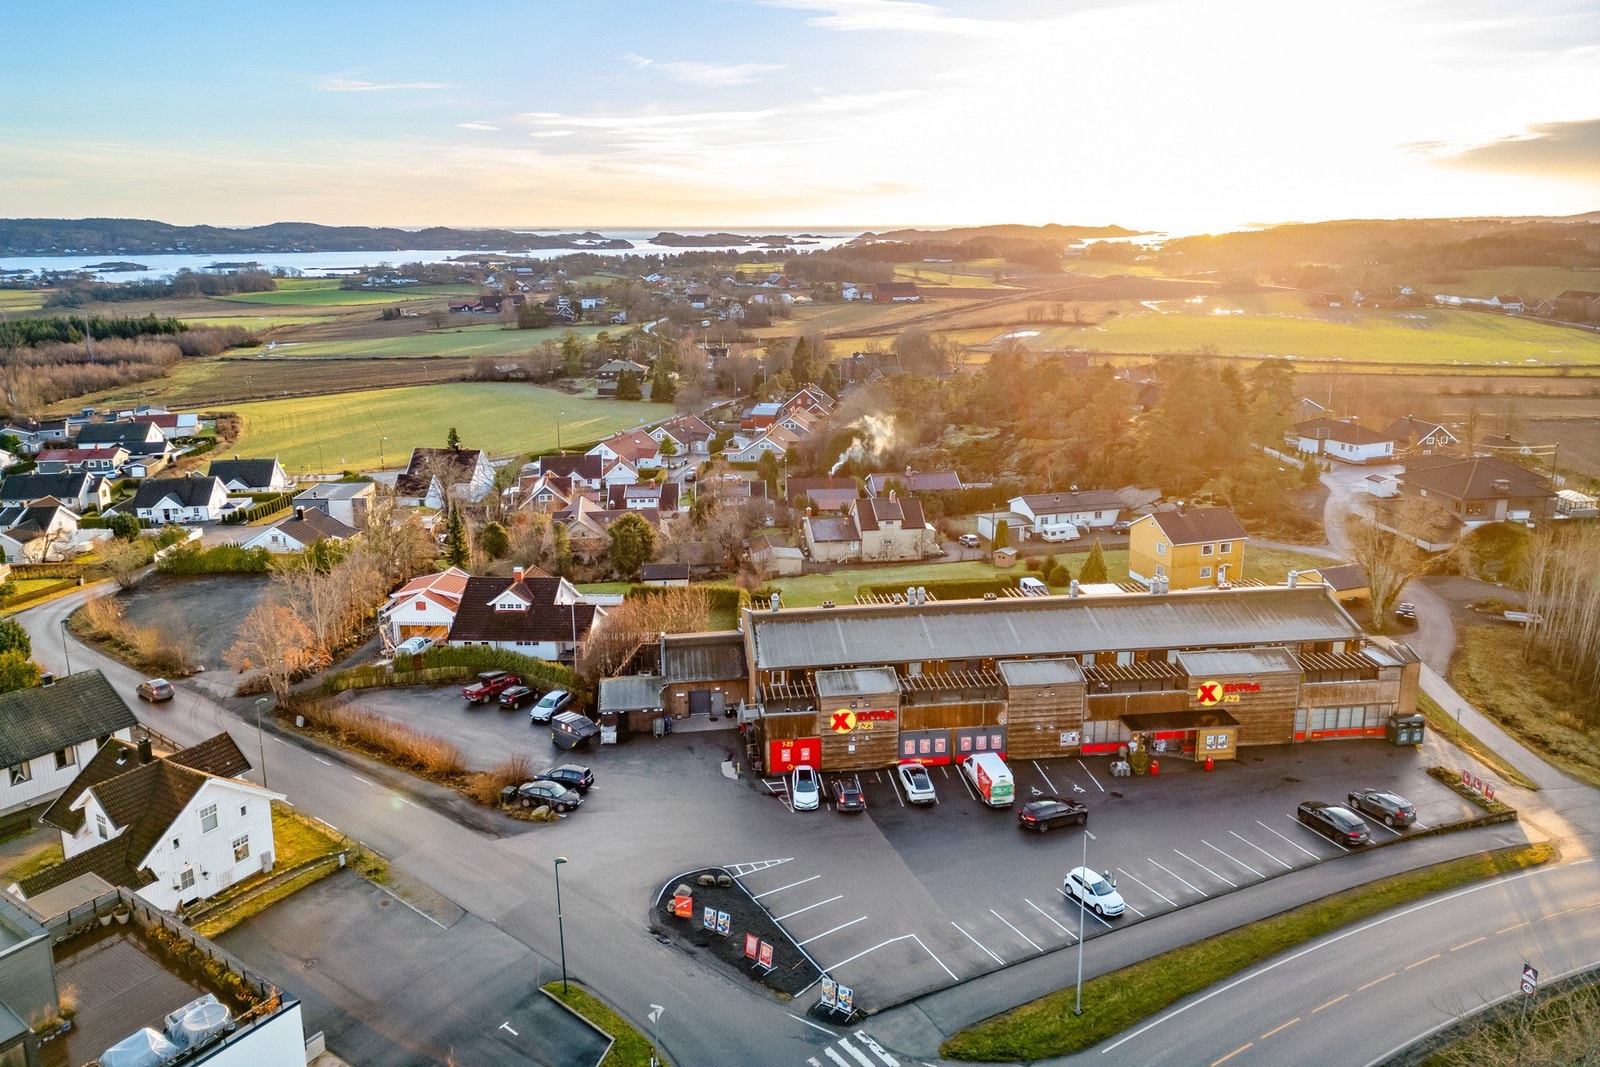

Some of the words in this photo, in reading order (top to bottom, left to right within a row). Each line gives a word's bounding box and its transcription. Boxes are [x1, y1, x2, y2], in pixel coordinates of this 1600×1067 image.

[1223, 682, 1260, 693] EXTRA
[1224, 695, 1240, 703] 7-23
[857, 710, 896, 721] EXTRA
[857, 722, 874, 730] 7-23
